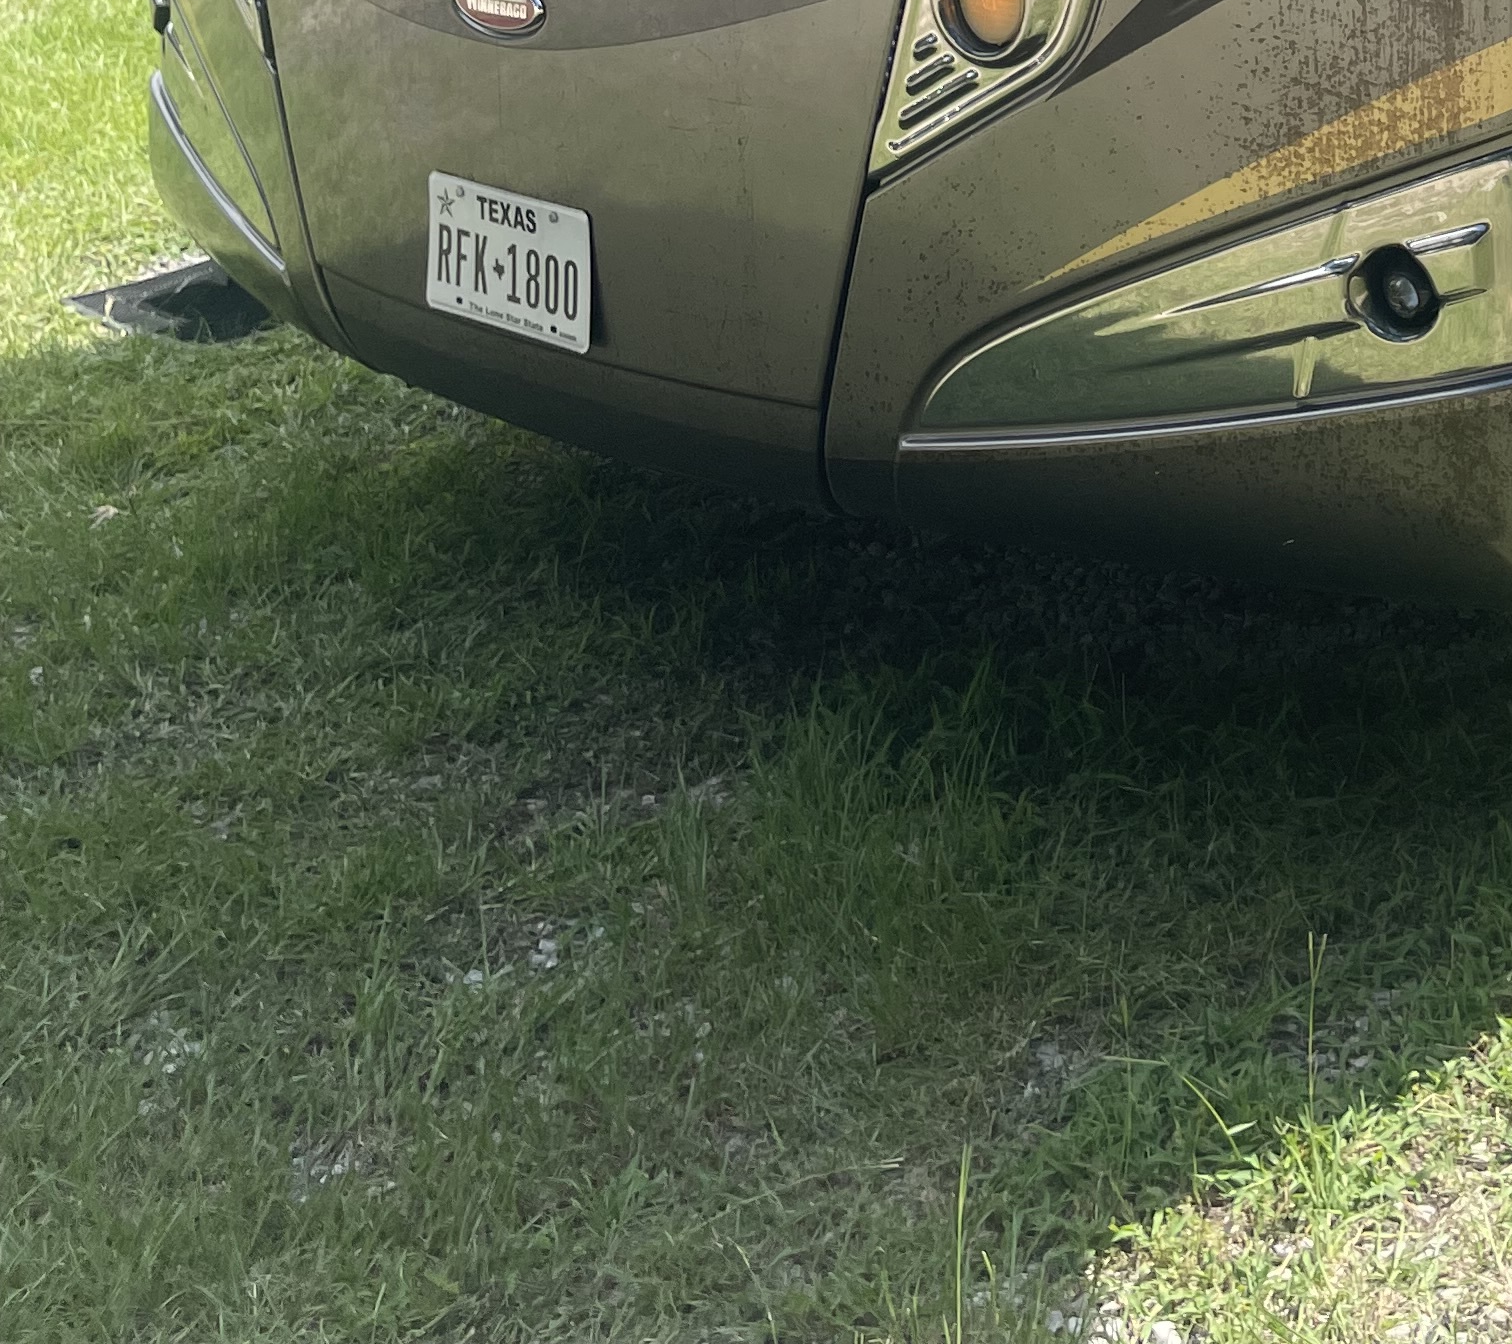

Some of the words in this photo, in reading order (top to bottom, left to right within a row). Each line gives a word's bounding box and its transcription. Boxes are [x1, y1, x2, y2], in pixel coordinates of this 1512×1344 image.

[476, 195, 537, 234] TEXAS
[437, 223, 488, 295] RFK
[506, 243, 579, 322] 1800
[468, 301, 483, 313] The
[485, 305, 504, 320] Lone
[506, 312, 521, 324] Star
[523, 318, 544, 332] State
